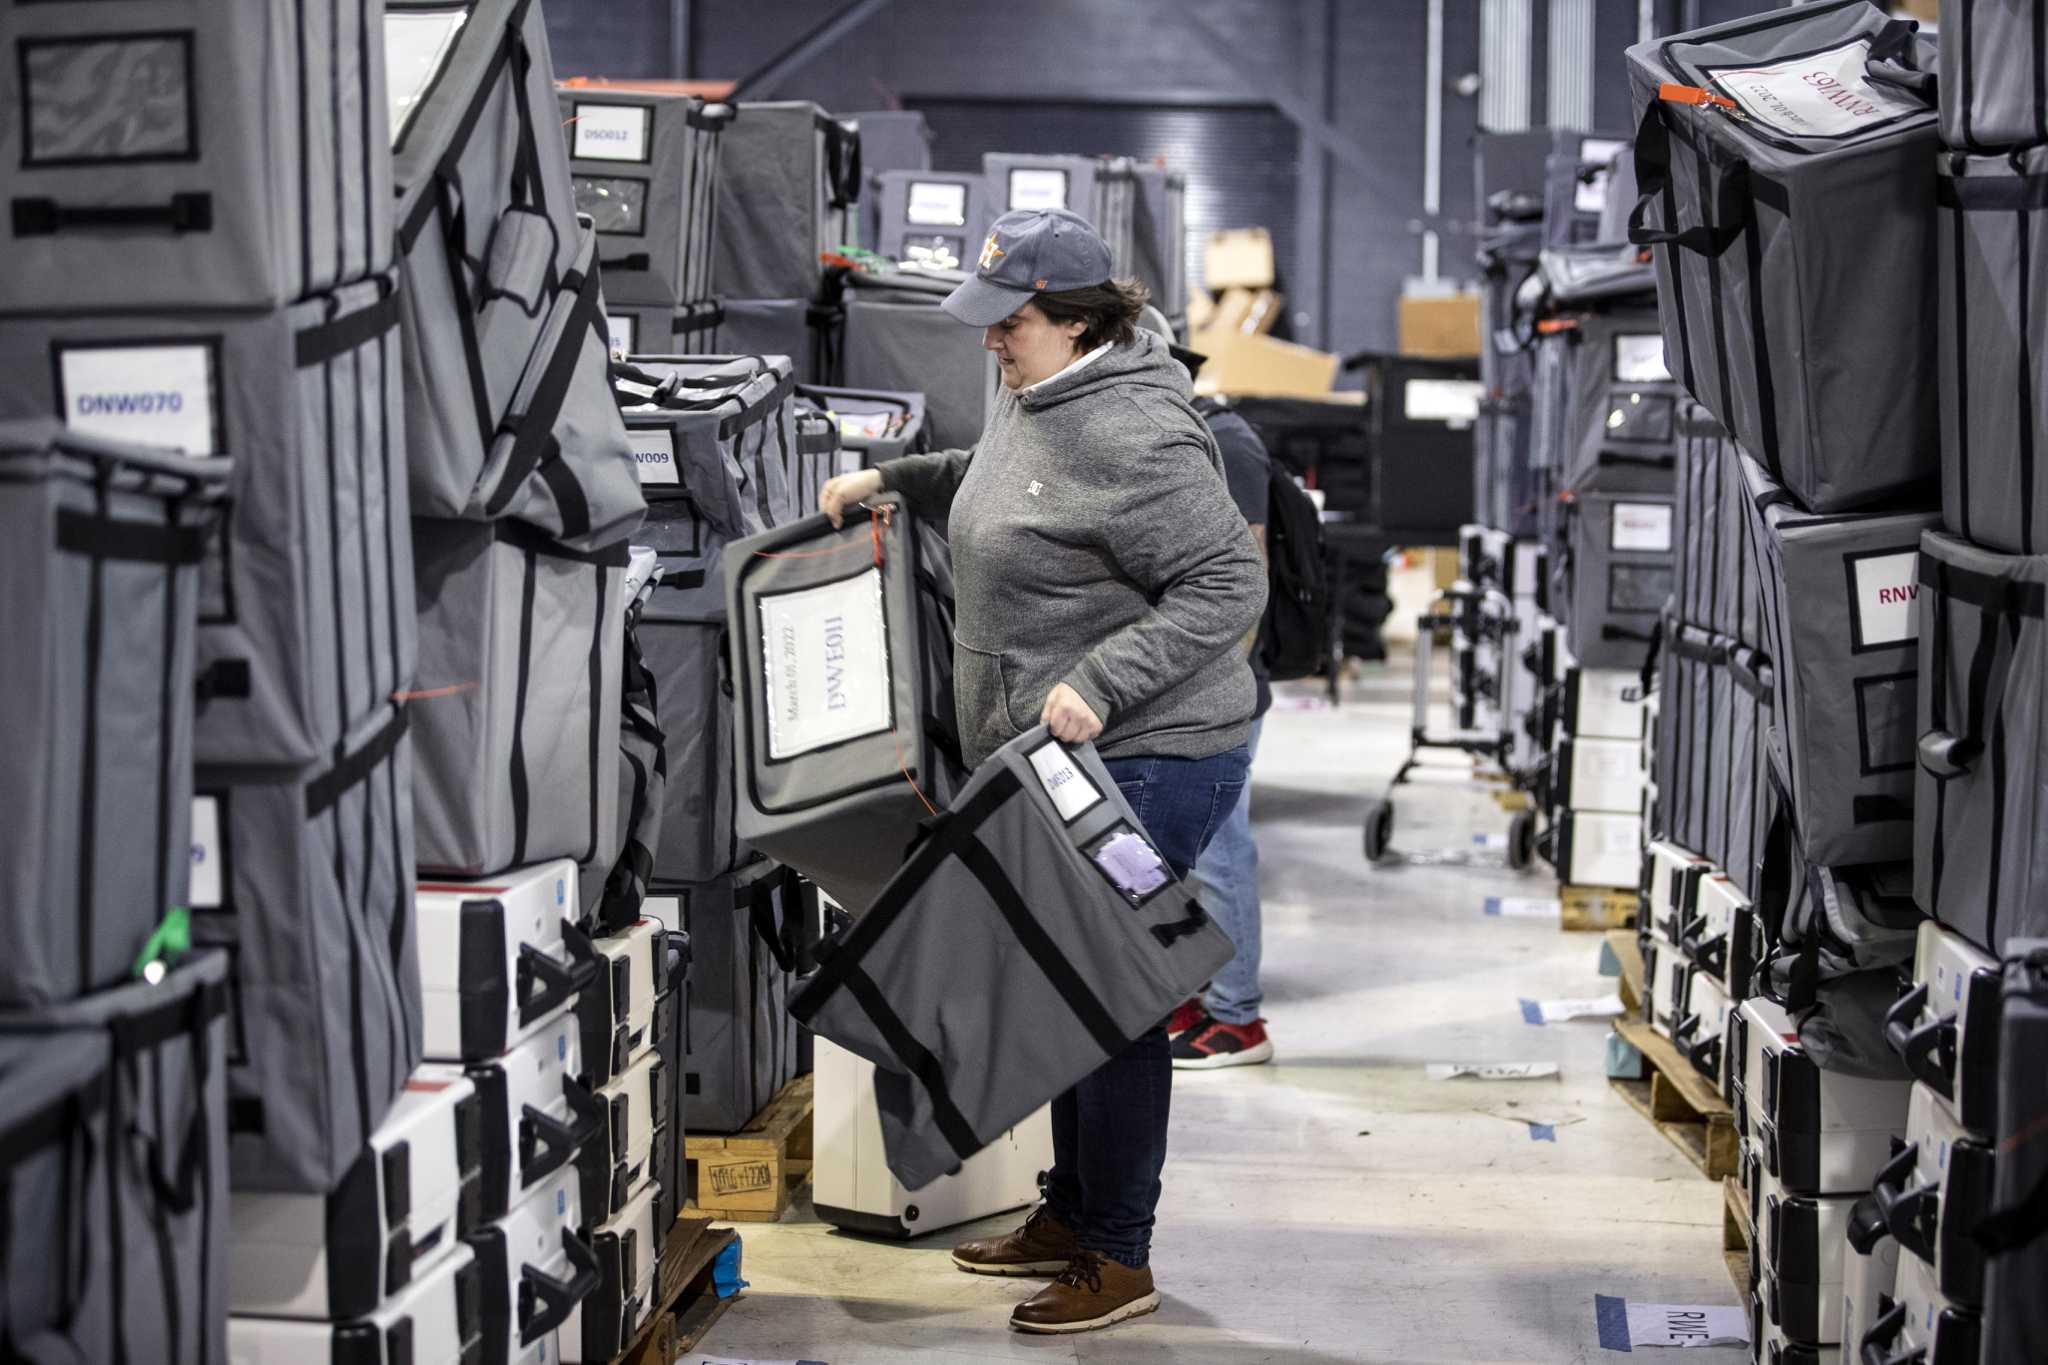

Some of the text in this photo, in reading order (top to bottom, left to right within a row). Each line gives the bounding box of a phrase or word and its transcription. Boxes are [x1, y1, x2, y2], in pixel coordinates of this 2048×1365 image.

[1803, 71, 1880, 117] RNW163
[76, 391, 184, 416] DNW070
[824, 616, 846, 711] DWE011
[1666, 1311, 1710, 1340] RWE
